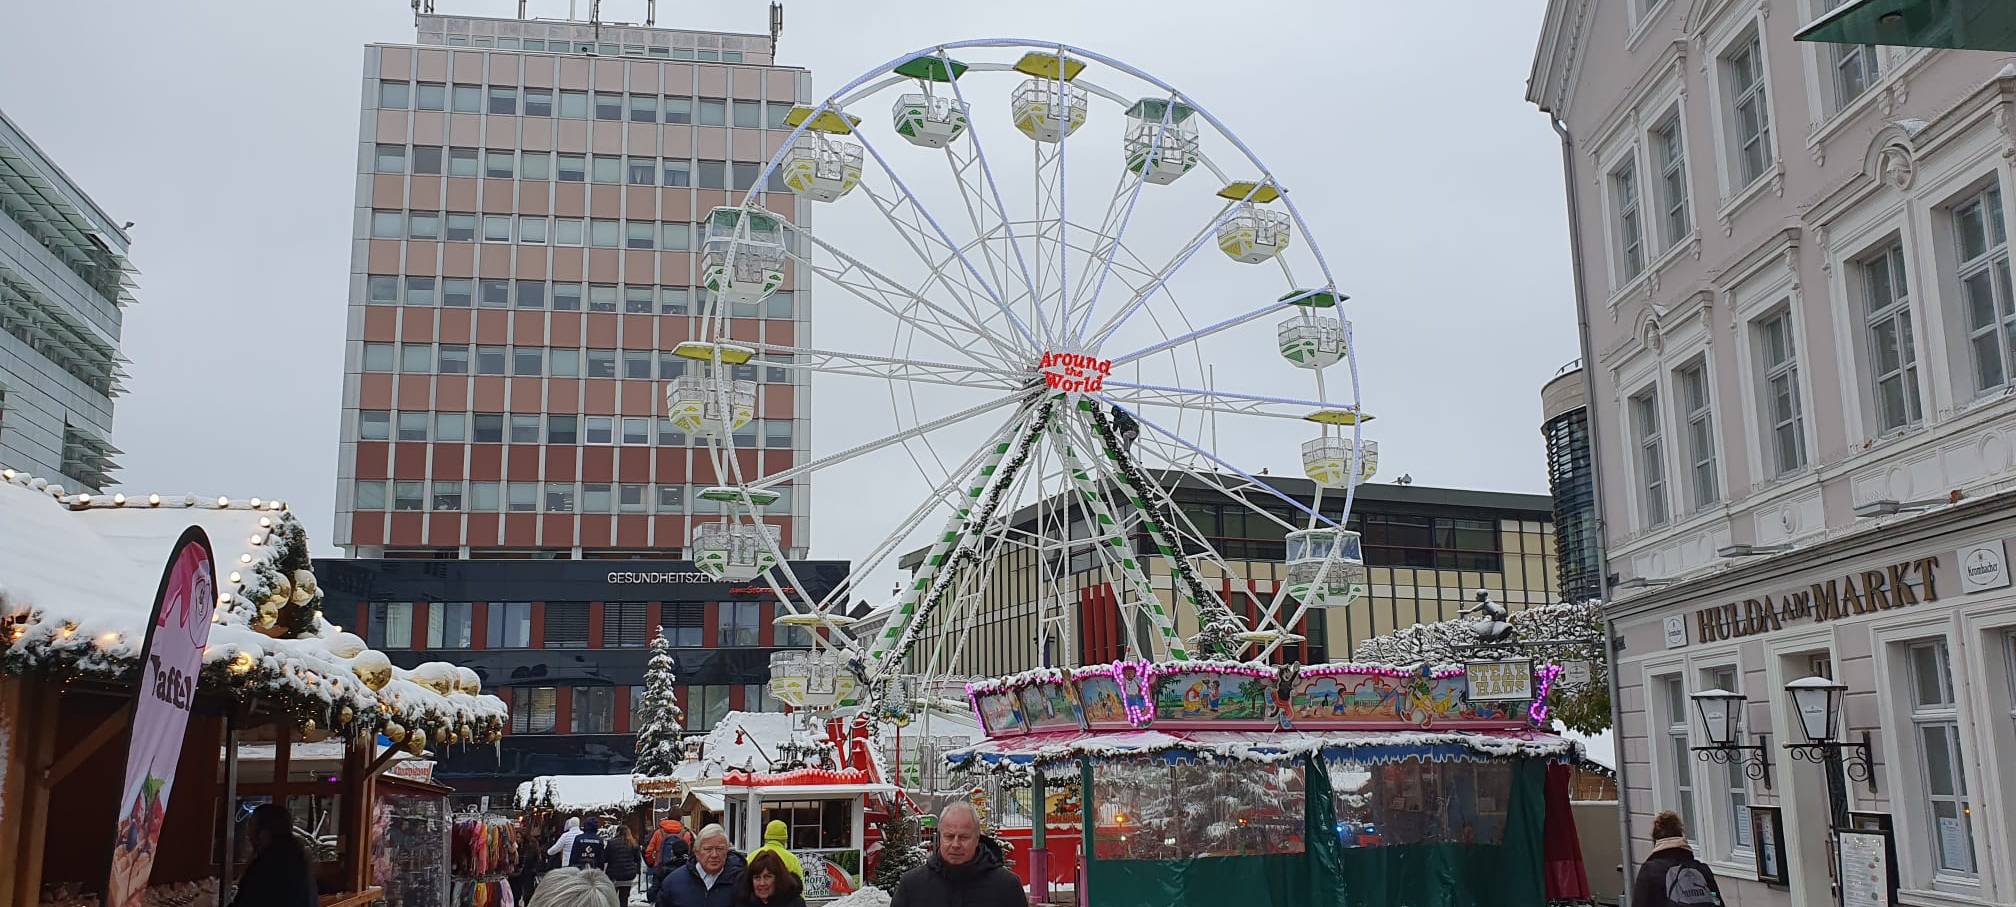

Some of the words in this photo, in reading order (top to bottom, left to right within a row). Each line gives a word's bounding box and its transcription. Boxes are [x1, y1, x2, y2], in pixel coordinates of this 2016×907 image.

[1038, 351, 1111, 375] Around
[1065, 367, 1083, 377] the
[1045, 371, 1104, 392] World
[607, 572, 720, 584] GESUNDHEITSZEN
[1696, 594, 1782, 643] HULDA
[1781, 590, 1812, 622] AM
[1811, 556, 1939, 623] MARKT
[1468, 664, 1529, 681] STEAK
